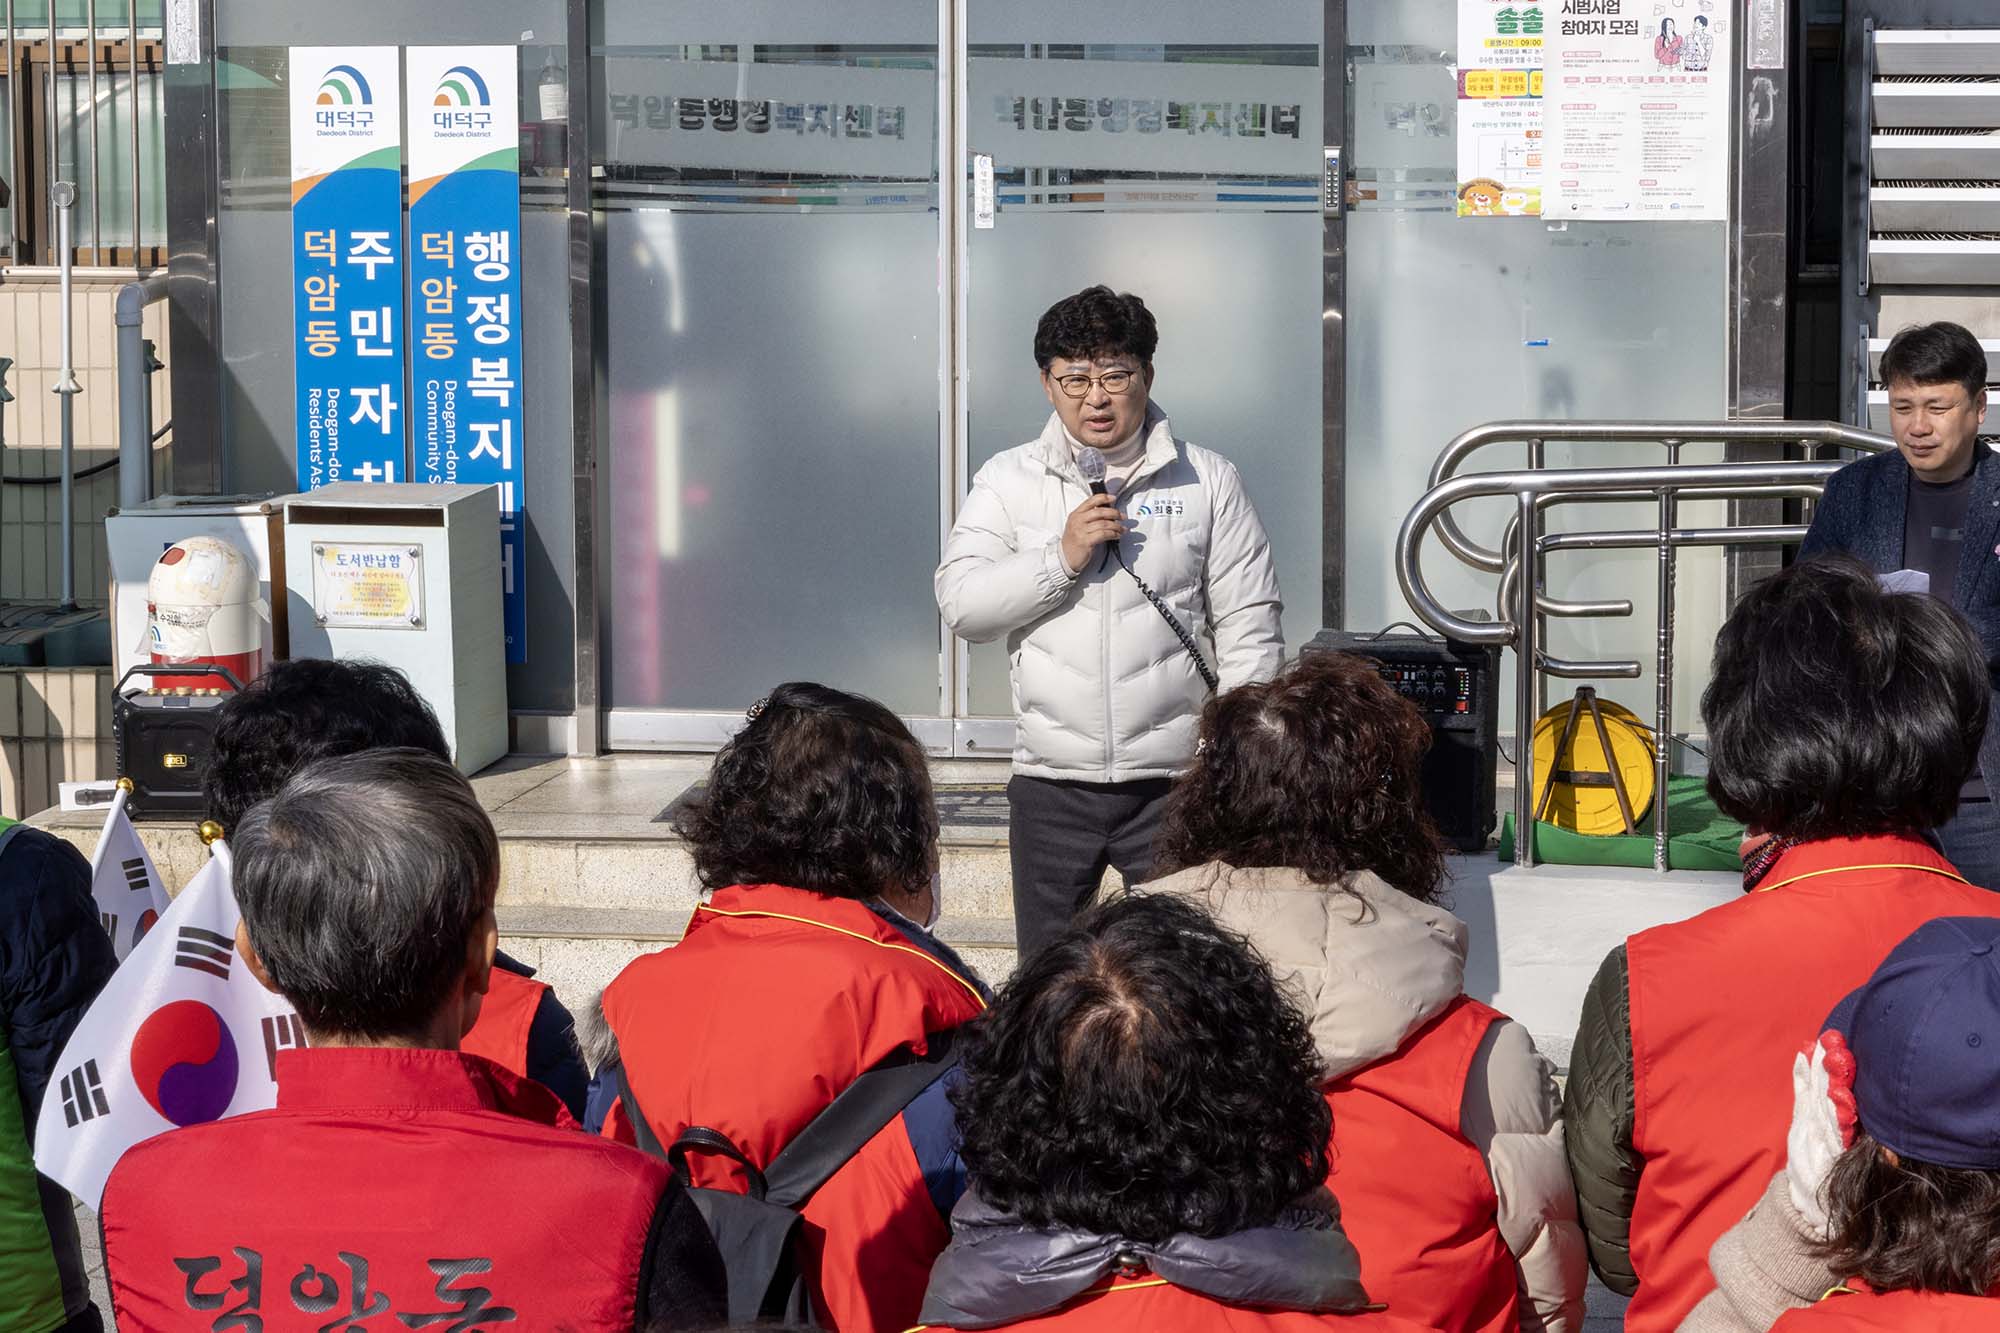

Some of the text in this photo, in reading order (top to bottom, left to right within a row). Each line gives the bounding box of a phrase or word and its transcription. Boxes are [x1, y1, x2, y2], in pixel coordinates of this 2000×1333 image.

[1561, 0, 1620, 15] 시범사업
[1561, 20, 1638, 35] 참여자 모집
[316, 111, 374, 127] 대덕구
[434, 112, 492, 128] 대덕구
[304, 229, 340, 357] 덕암동
[421, 231, 458, 359] 덕암동
[309, 388, 323, 464] Residents'
[325, 388, 342, 482] Deogam-do
[425, 379, 441, 471] Community
[1154, 505, 1183, 515] 최충규
[336, 553, 401, 569] 도서반납함
[172, 1246, 517, 1333] 덕암동
